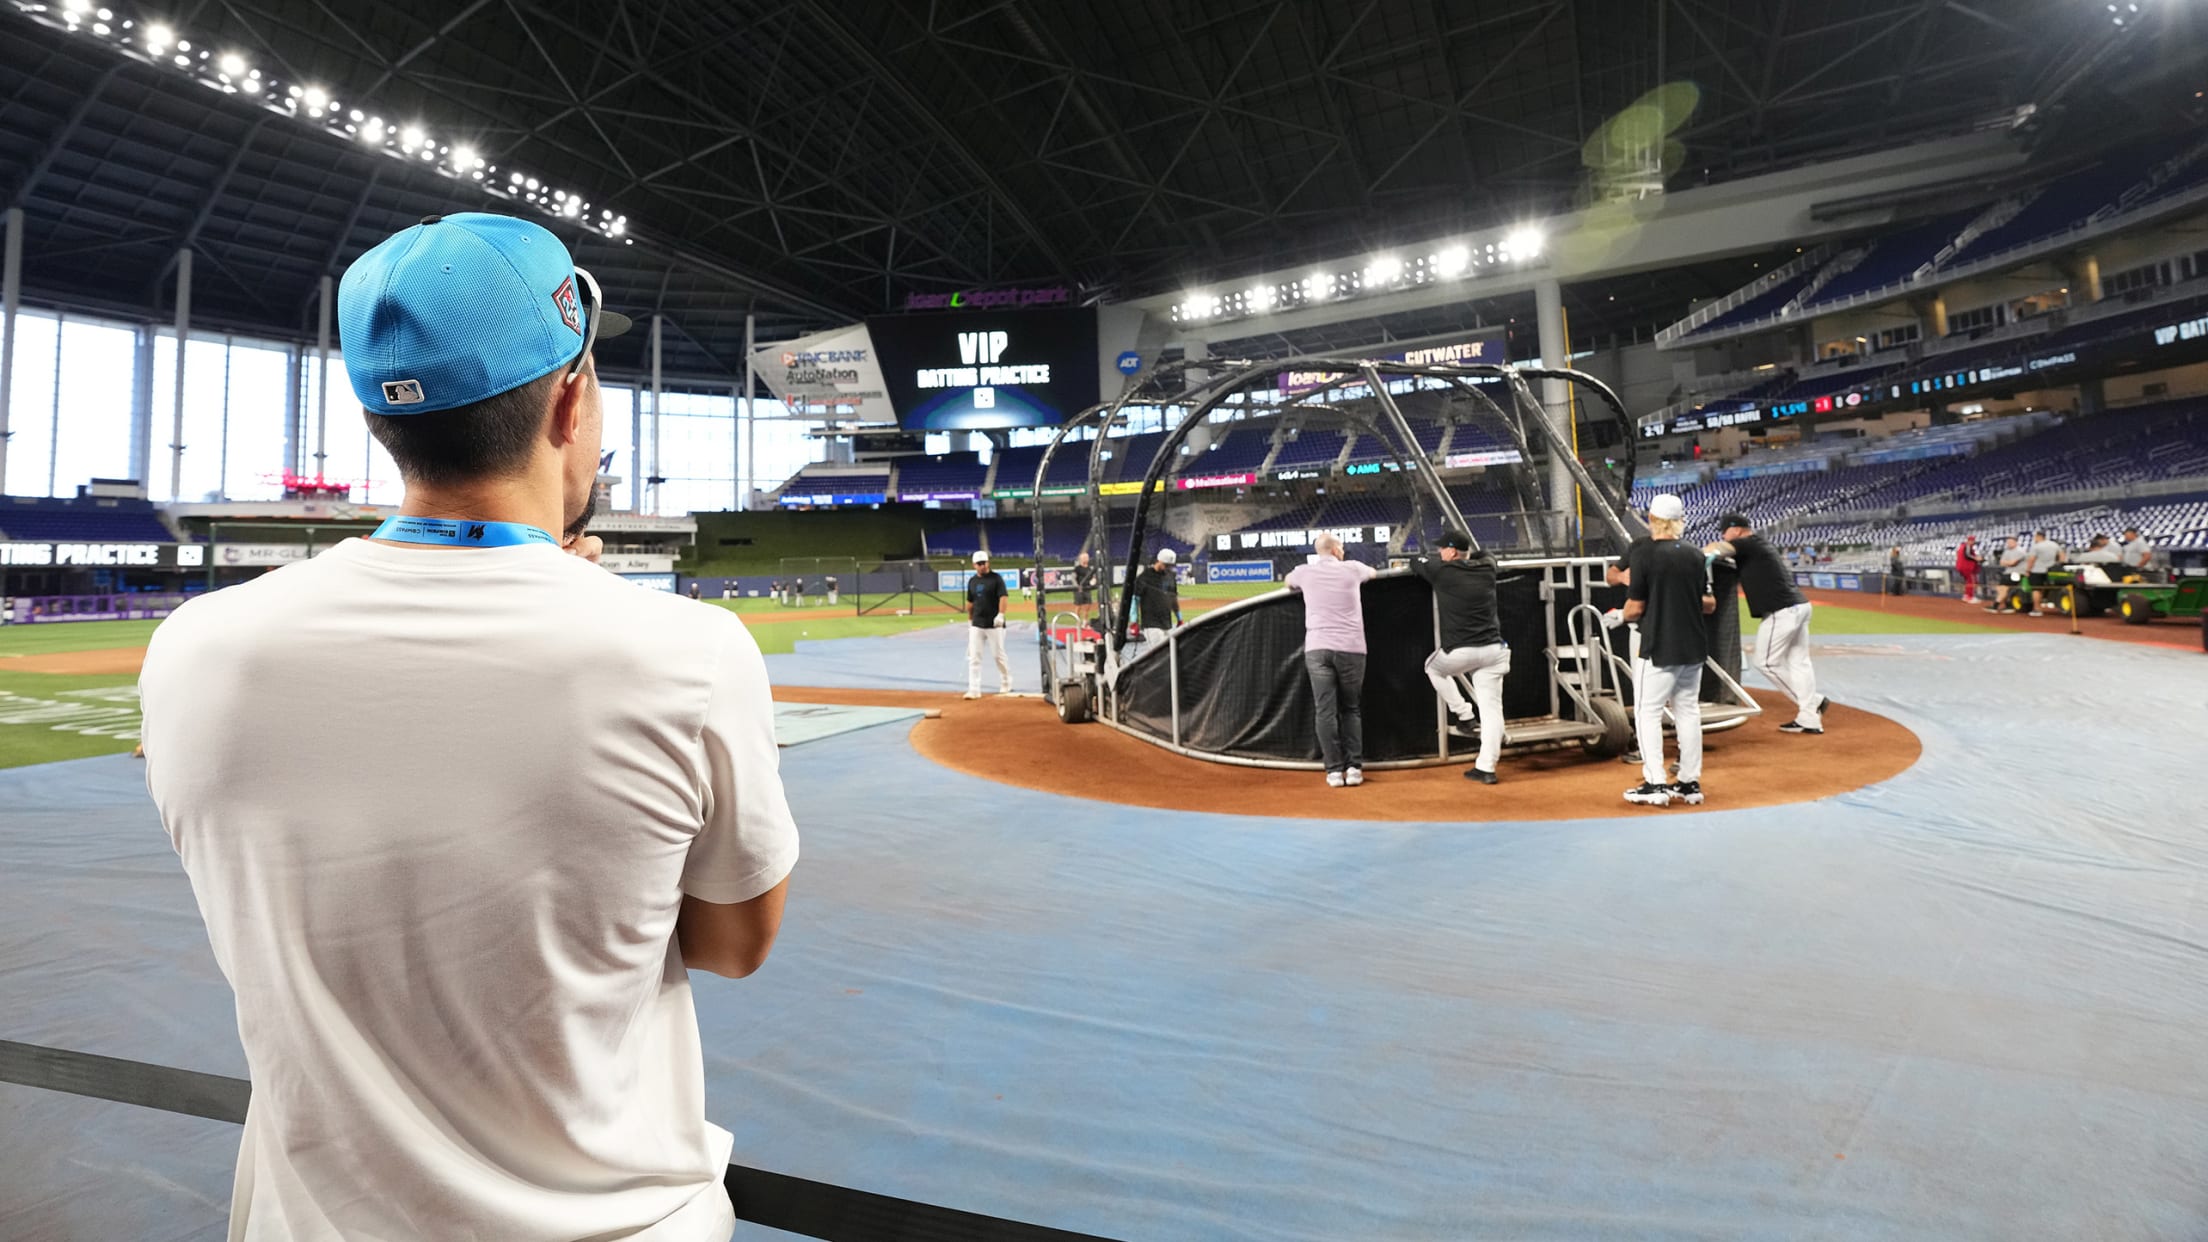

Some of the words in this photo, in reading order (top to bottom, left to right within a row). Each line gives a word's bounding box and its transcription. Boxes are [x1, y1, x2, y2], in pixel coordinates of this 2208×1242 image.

[2154, 325, 2178, 345] VIP
[2179, 317, 2208, 340] BAT
[957, 331, 1008, 364] VIP
[1405, 341, 1483, 365] CUTWATER
[1120, 357, 1138, 368] ADT
[786, 367, 858, 382] AutoNation
[917, 367, 978, 388] BATTING
[980, 364, 1050, 386] PRACTICE
[1735, 409, 1760, 425] RAFFLE
[1356, 463, 1380, 475] AMG
[1240, 532, 1259, 548] VIP
[1261, 530, 1307, 547] BATTING
[1308, 527, 1363, 545] PRCTICE
[56, 544, 159, 565] PRACTICE
[1220, 568, 1247, 577] OCEAN
[1248, 567, 1270, 577] BANK
